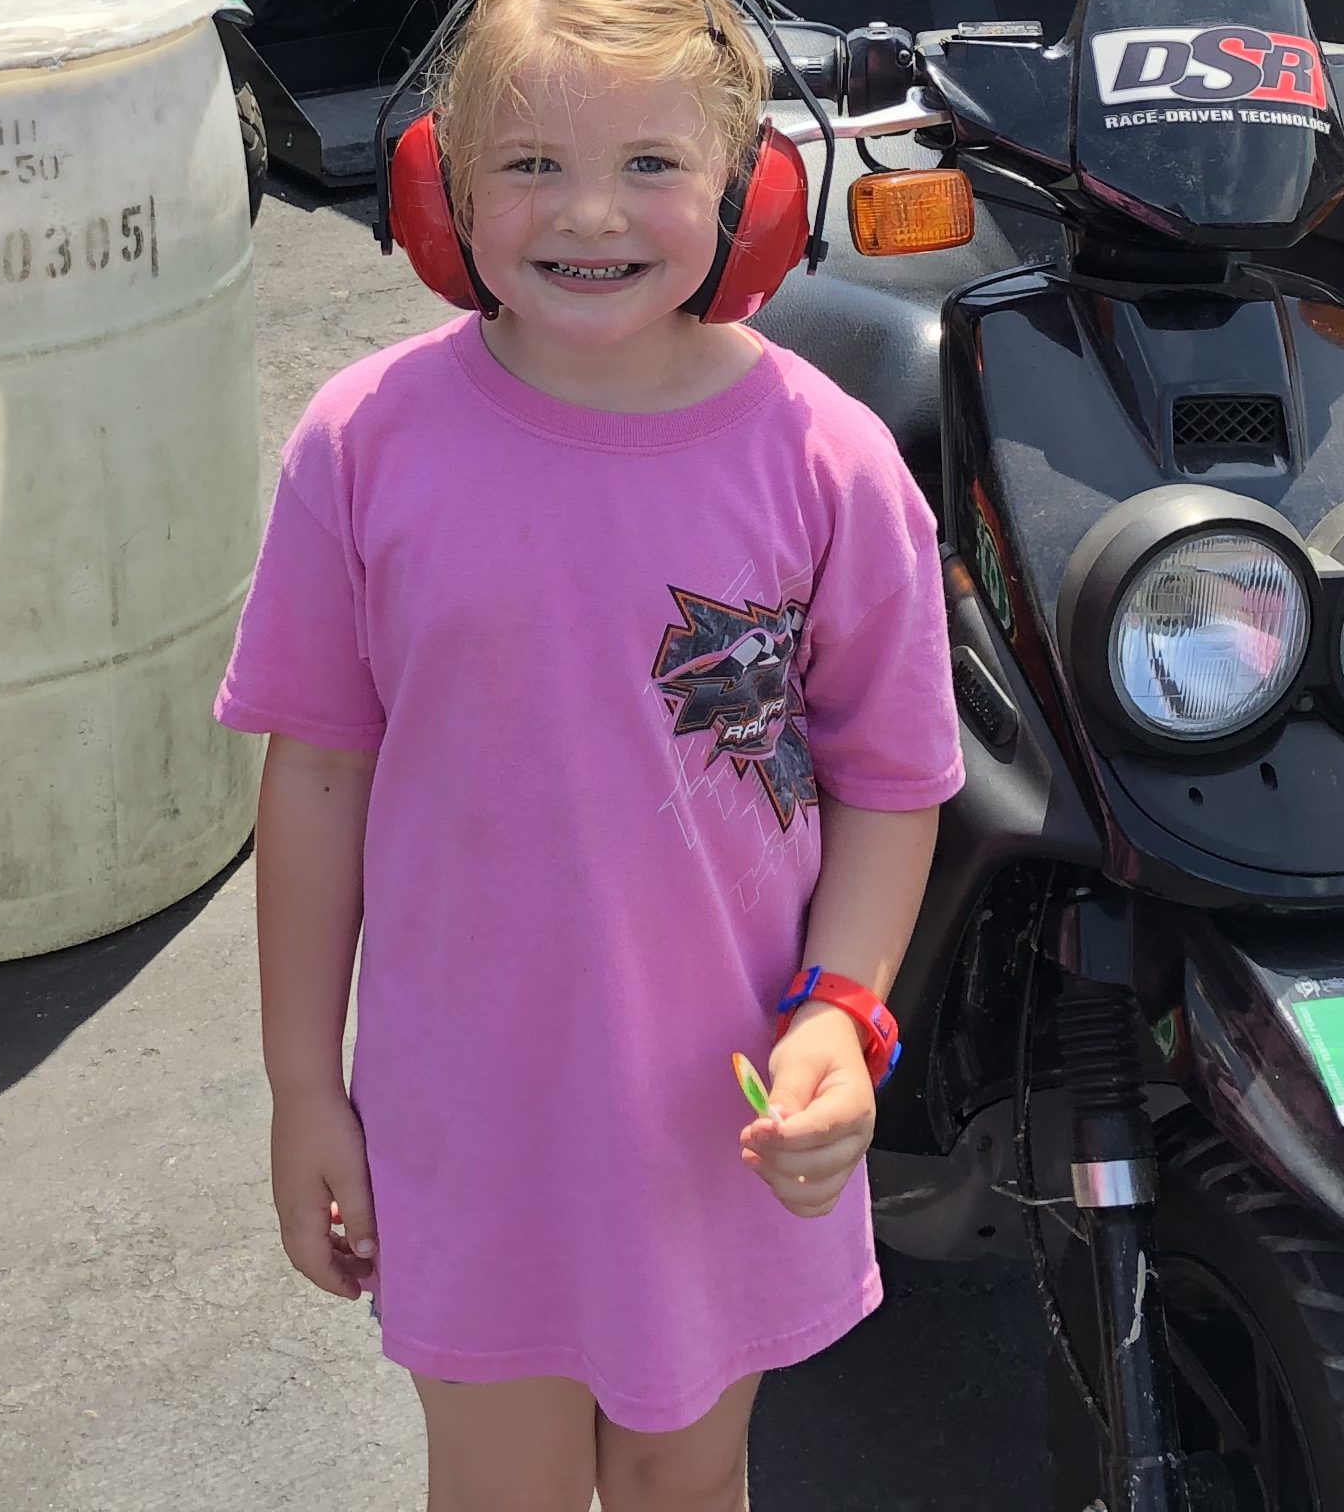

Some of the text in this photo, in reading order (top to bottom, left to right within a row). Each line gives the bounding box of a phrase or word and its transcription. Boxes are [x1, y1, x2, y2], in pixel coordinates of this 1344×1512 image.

[1111, 27, 1314, 100] DSR
[1105, 108, 1331, 135] RACE-DRIVEN TECHNOLOGY
